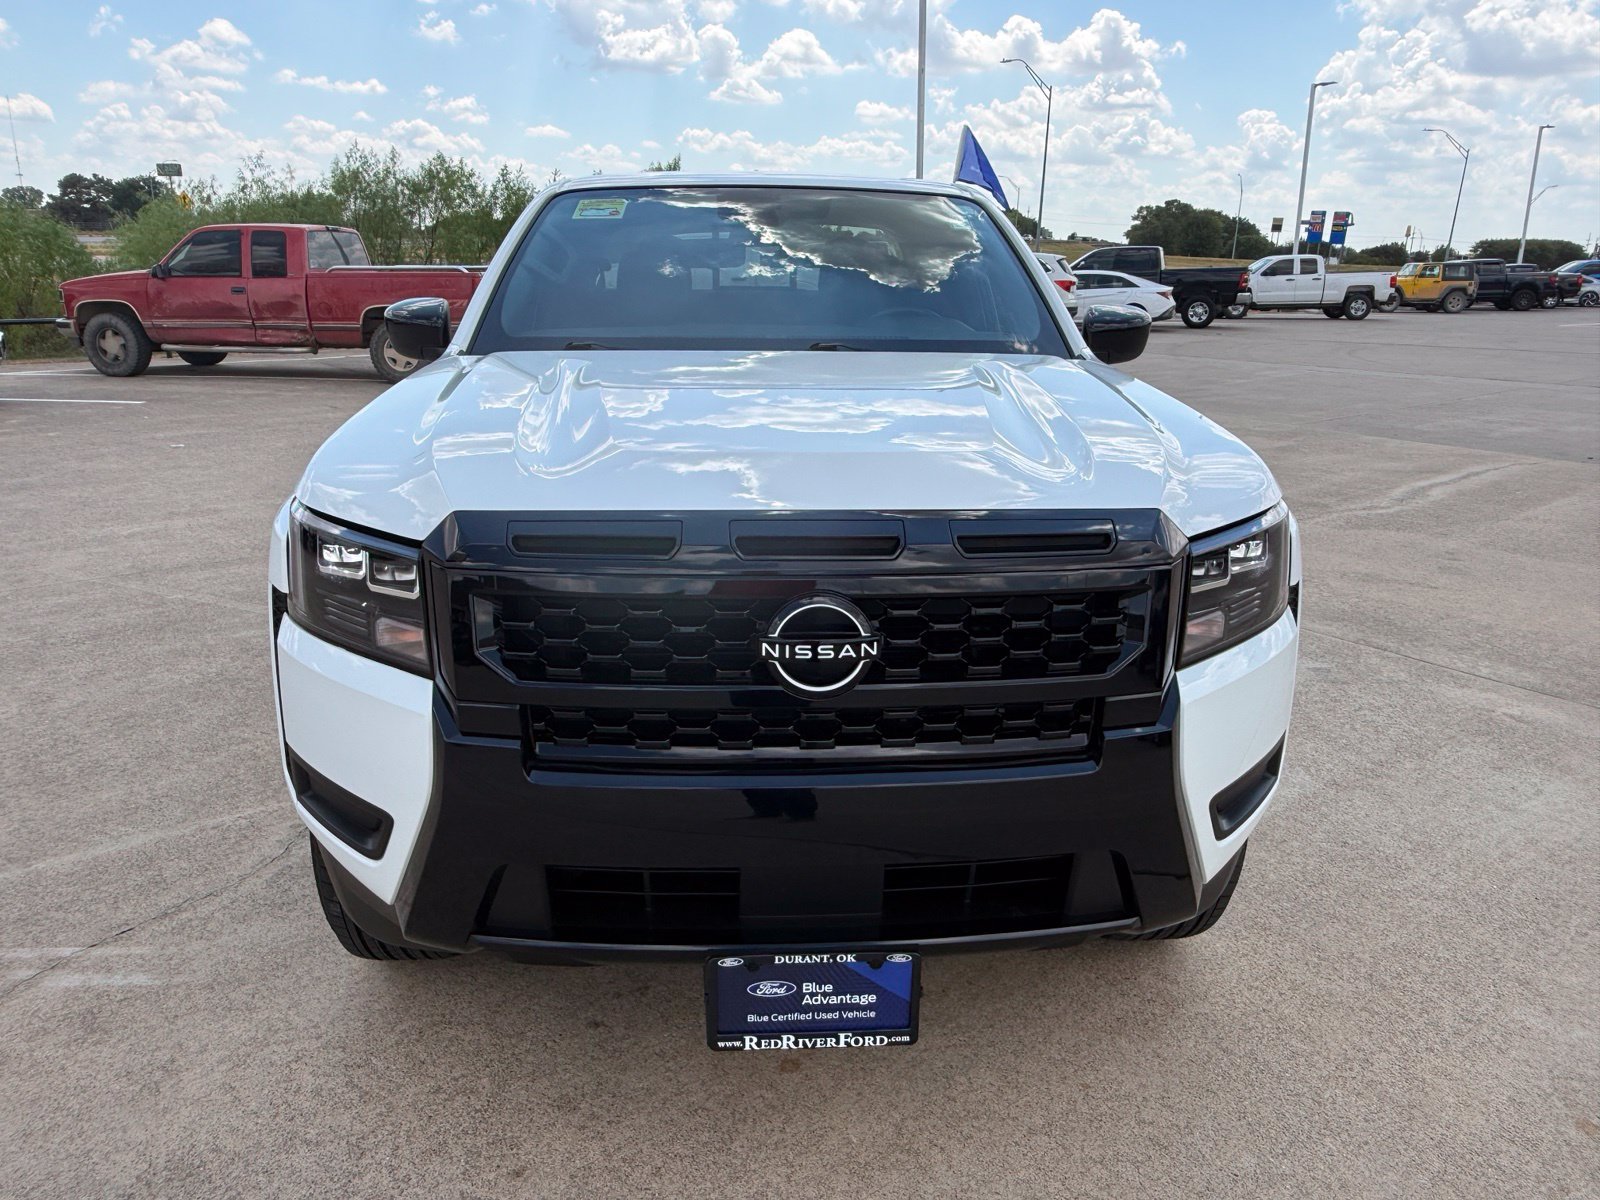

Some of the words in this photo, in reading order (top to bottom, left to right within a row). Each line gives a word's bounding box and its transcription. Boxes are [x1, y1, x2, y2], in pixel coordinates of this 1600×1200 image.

[762, 641, 877, 659] NISSAN
[774, 954, 833, 964] DURANT,
[836, 953, 857, 963] OK
[802, 982, 833, 993] Blue
[802, 993, 877, 1005] Advantage
[747, 1013, 769, 1022] Blue
[771, 1011, 812, 1022] Certified
[814, 1011, 840, 1020] Used
[842, 1009, 877, 1018] Vehicle
